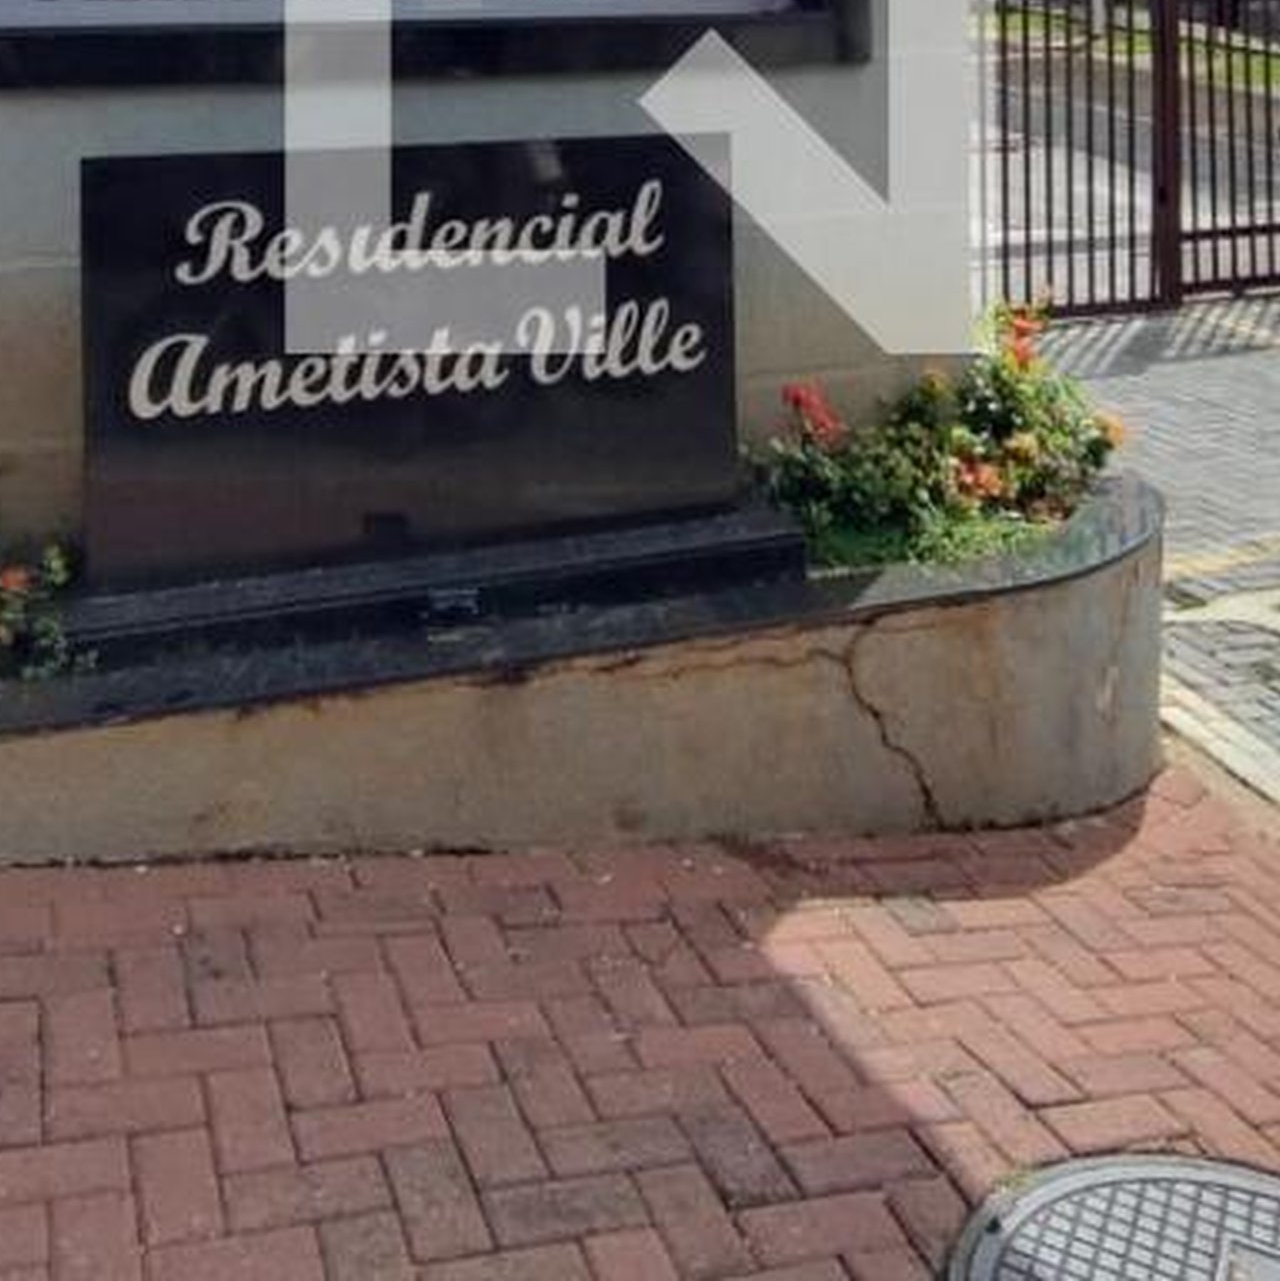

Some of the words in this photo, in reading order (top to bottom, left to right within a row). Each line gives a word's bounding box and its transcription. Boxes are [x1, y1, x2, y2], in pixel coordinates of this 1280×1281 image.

[175, 179, 665, 285] Residencial
[128, 326, 510, 419] Ametista
[518, 297, 708, 385] Ville
